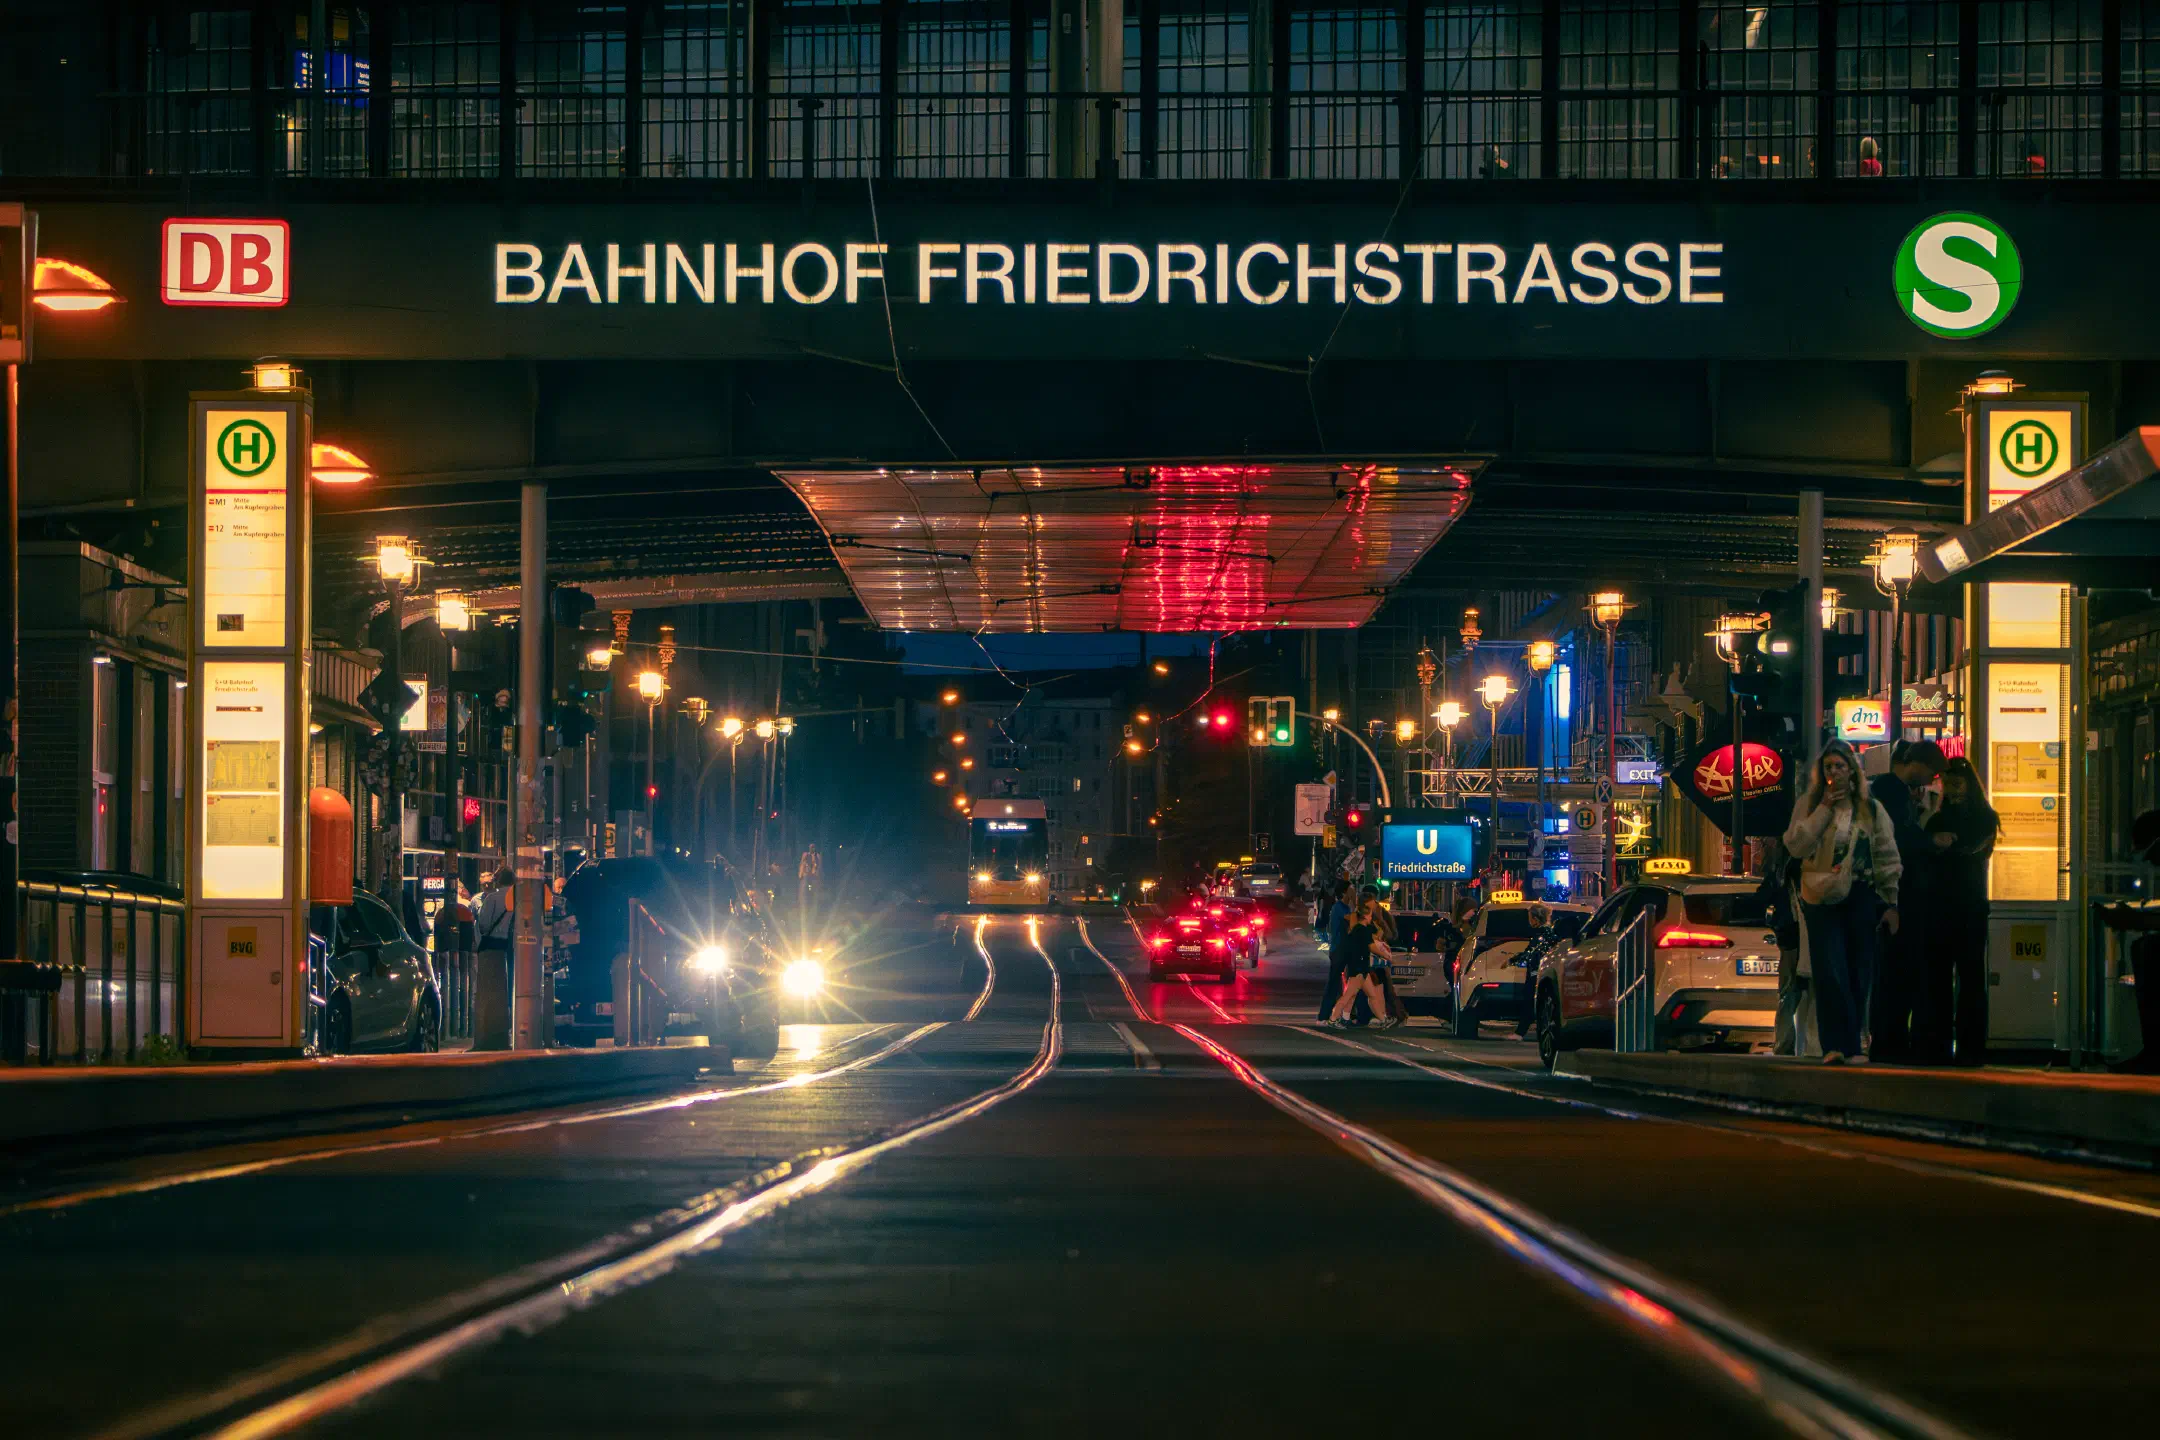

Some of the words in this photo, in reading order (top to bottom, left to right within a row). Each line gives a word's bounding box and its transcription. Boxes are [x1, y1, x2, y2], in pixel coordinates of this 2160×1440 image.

[180, 232, 275, 294] DB
[494, 243, 889, 305] BAHNHOF
[918, 243, 1724, 305] FRIEDRICHSTRASSE
[1912, 221, 2001, 330] S
[233, 432, 261, 464] H
[2016, 433, 2043, 464] H
[215, 498, 226, 506] M1
[215, 524, 224, 533] 12
[1851, 707, 1879, 723] dm
[1629, 769, 1656, 780] EXIT
[1581, 812, 1591, 826] H
[1416, 829, 1438, 855] U
[1388, 861, 1466, 873] Friedrichstraße
[230, 941, 253, 954] BVG
[2016, 942, 2042, 957] BVG
